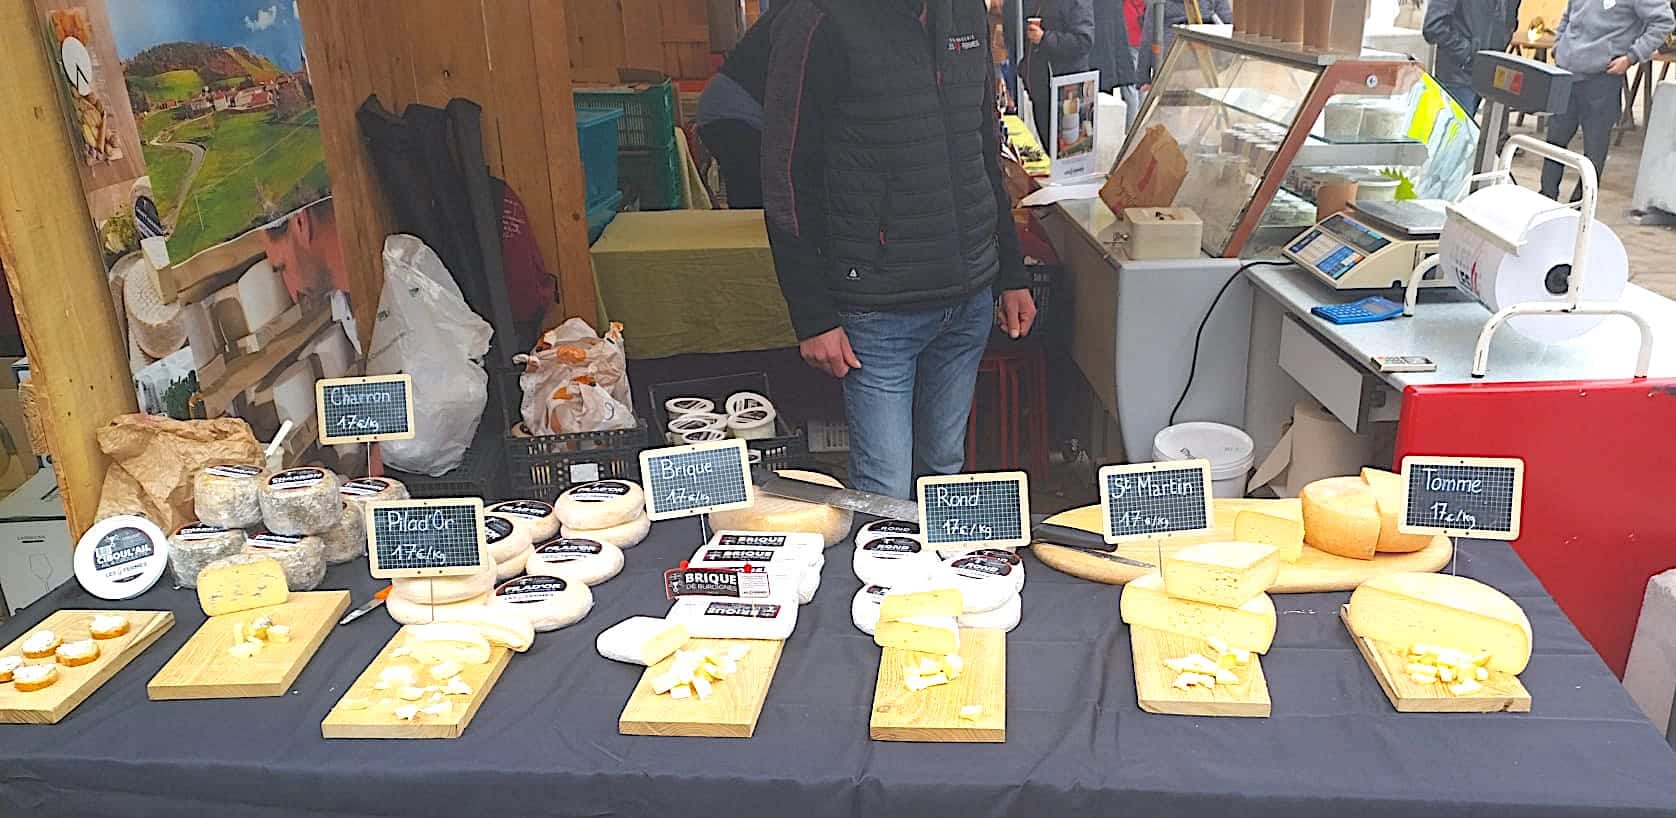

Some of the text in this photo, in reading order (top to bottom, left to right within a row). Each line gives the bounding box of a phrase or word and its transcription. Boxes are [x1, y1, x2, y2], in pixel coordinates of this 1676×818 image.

[331, 387, 391, 406] Charron
[661, 459, 713, 484] Brique
[1422, 468, 1483, 493] Tomme
[1112, 475, 1193, 498] St Martin
[937, 487, 979, 507] Rond
[388, 510, 455, 531] Pilad'Or
[97, 544, 152, 564] CIBOUL'AIL
[685, 572, 738, 586] BRIQUE
